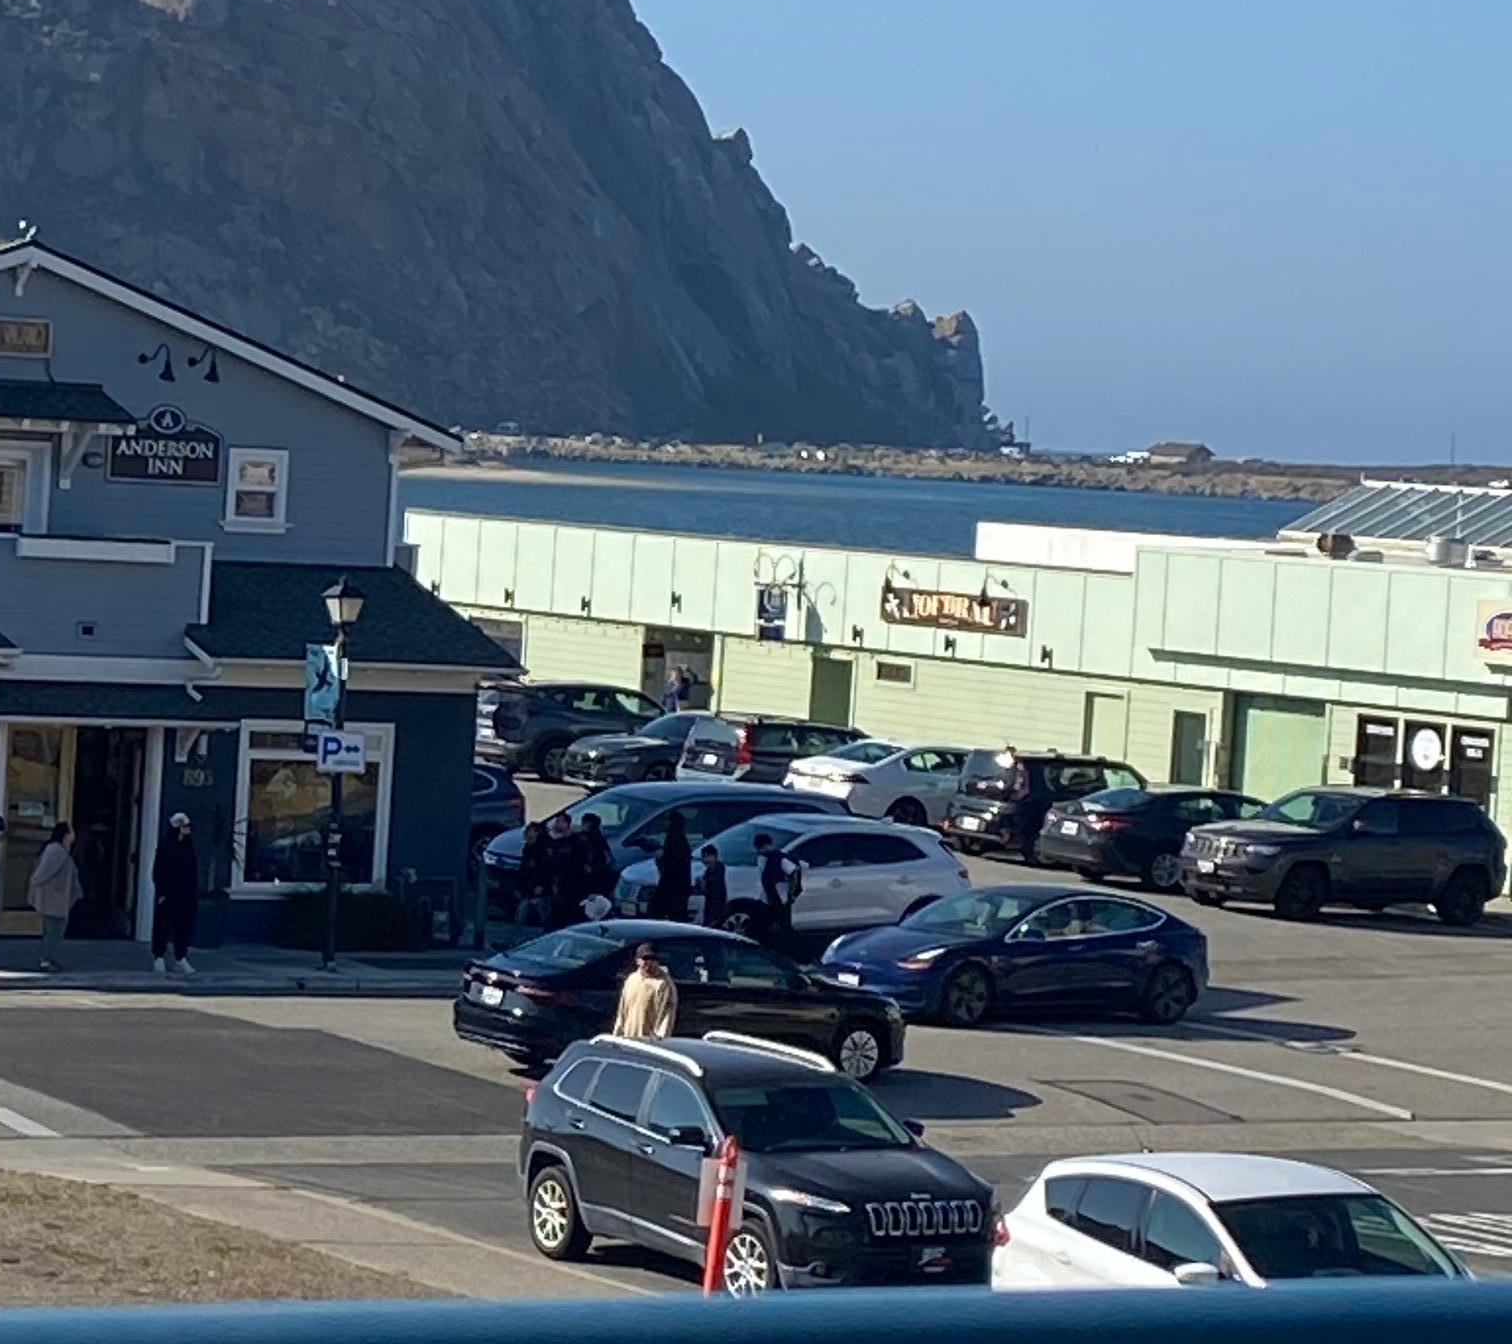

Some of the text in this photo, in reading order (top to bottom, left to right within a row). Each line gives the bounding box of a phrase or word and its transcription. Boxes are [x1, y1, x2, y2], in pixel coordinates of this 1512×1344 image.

[160, 411, 174, 427] A
[115, 439, 215, 459] ANDERSON
[147, 458, 184, 475] INN
[322, 736, 342, 764] P
